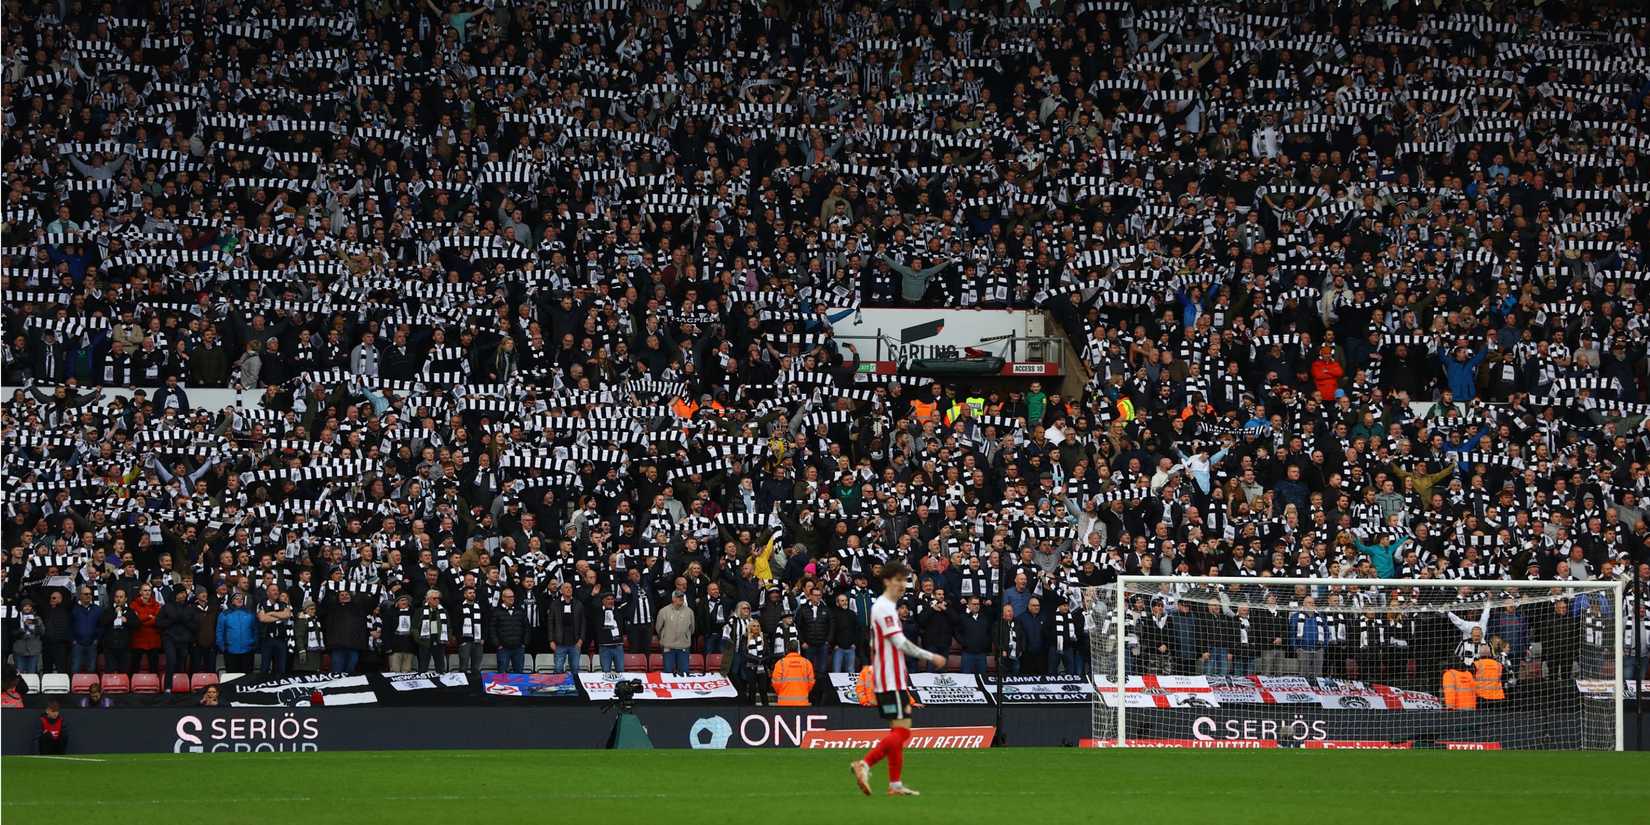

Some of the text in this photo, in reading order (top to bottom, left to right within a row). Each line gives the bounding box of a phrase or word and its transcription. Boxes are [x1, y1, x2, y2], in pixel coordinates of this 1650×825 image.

[1045, 674, 1081, 682] MAGS
[679, 680, 728, 690] MAGS
[210, 712, 319, 740] SERIÖS
[907, 736, 932, 749] FLY
